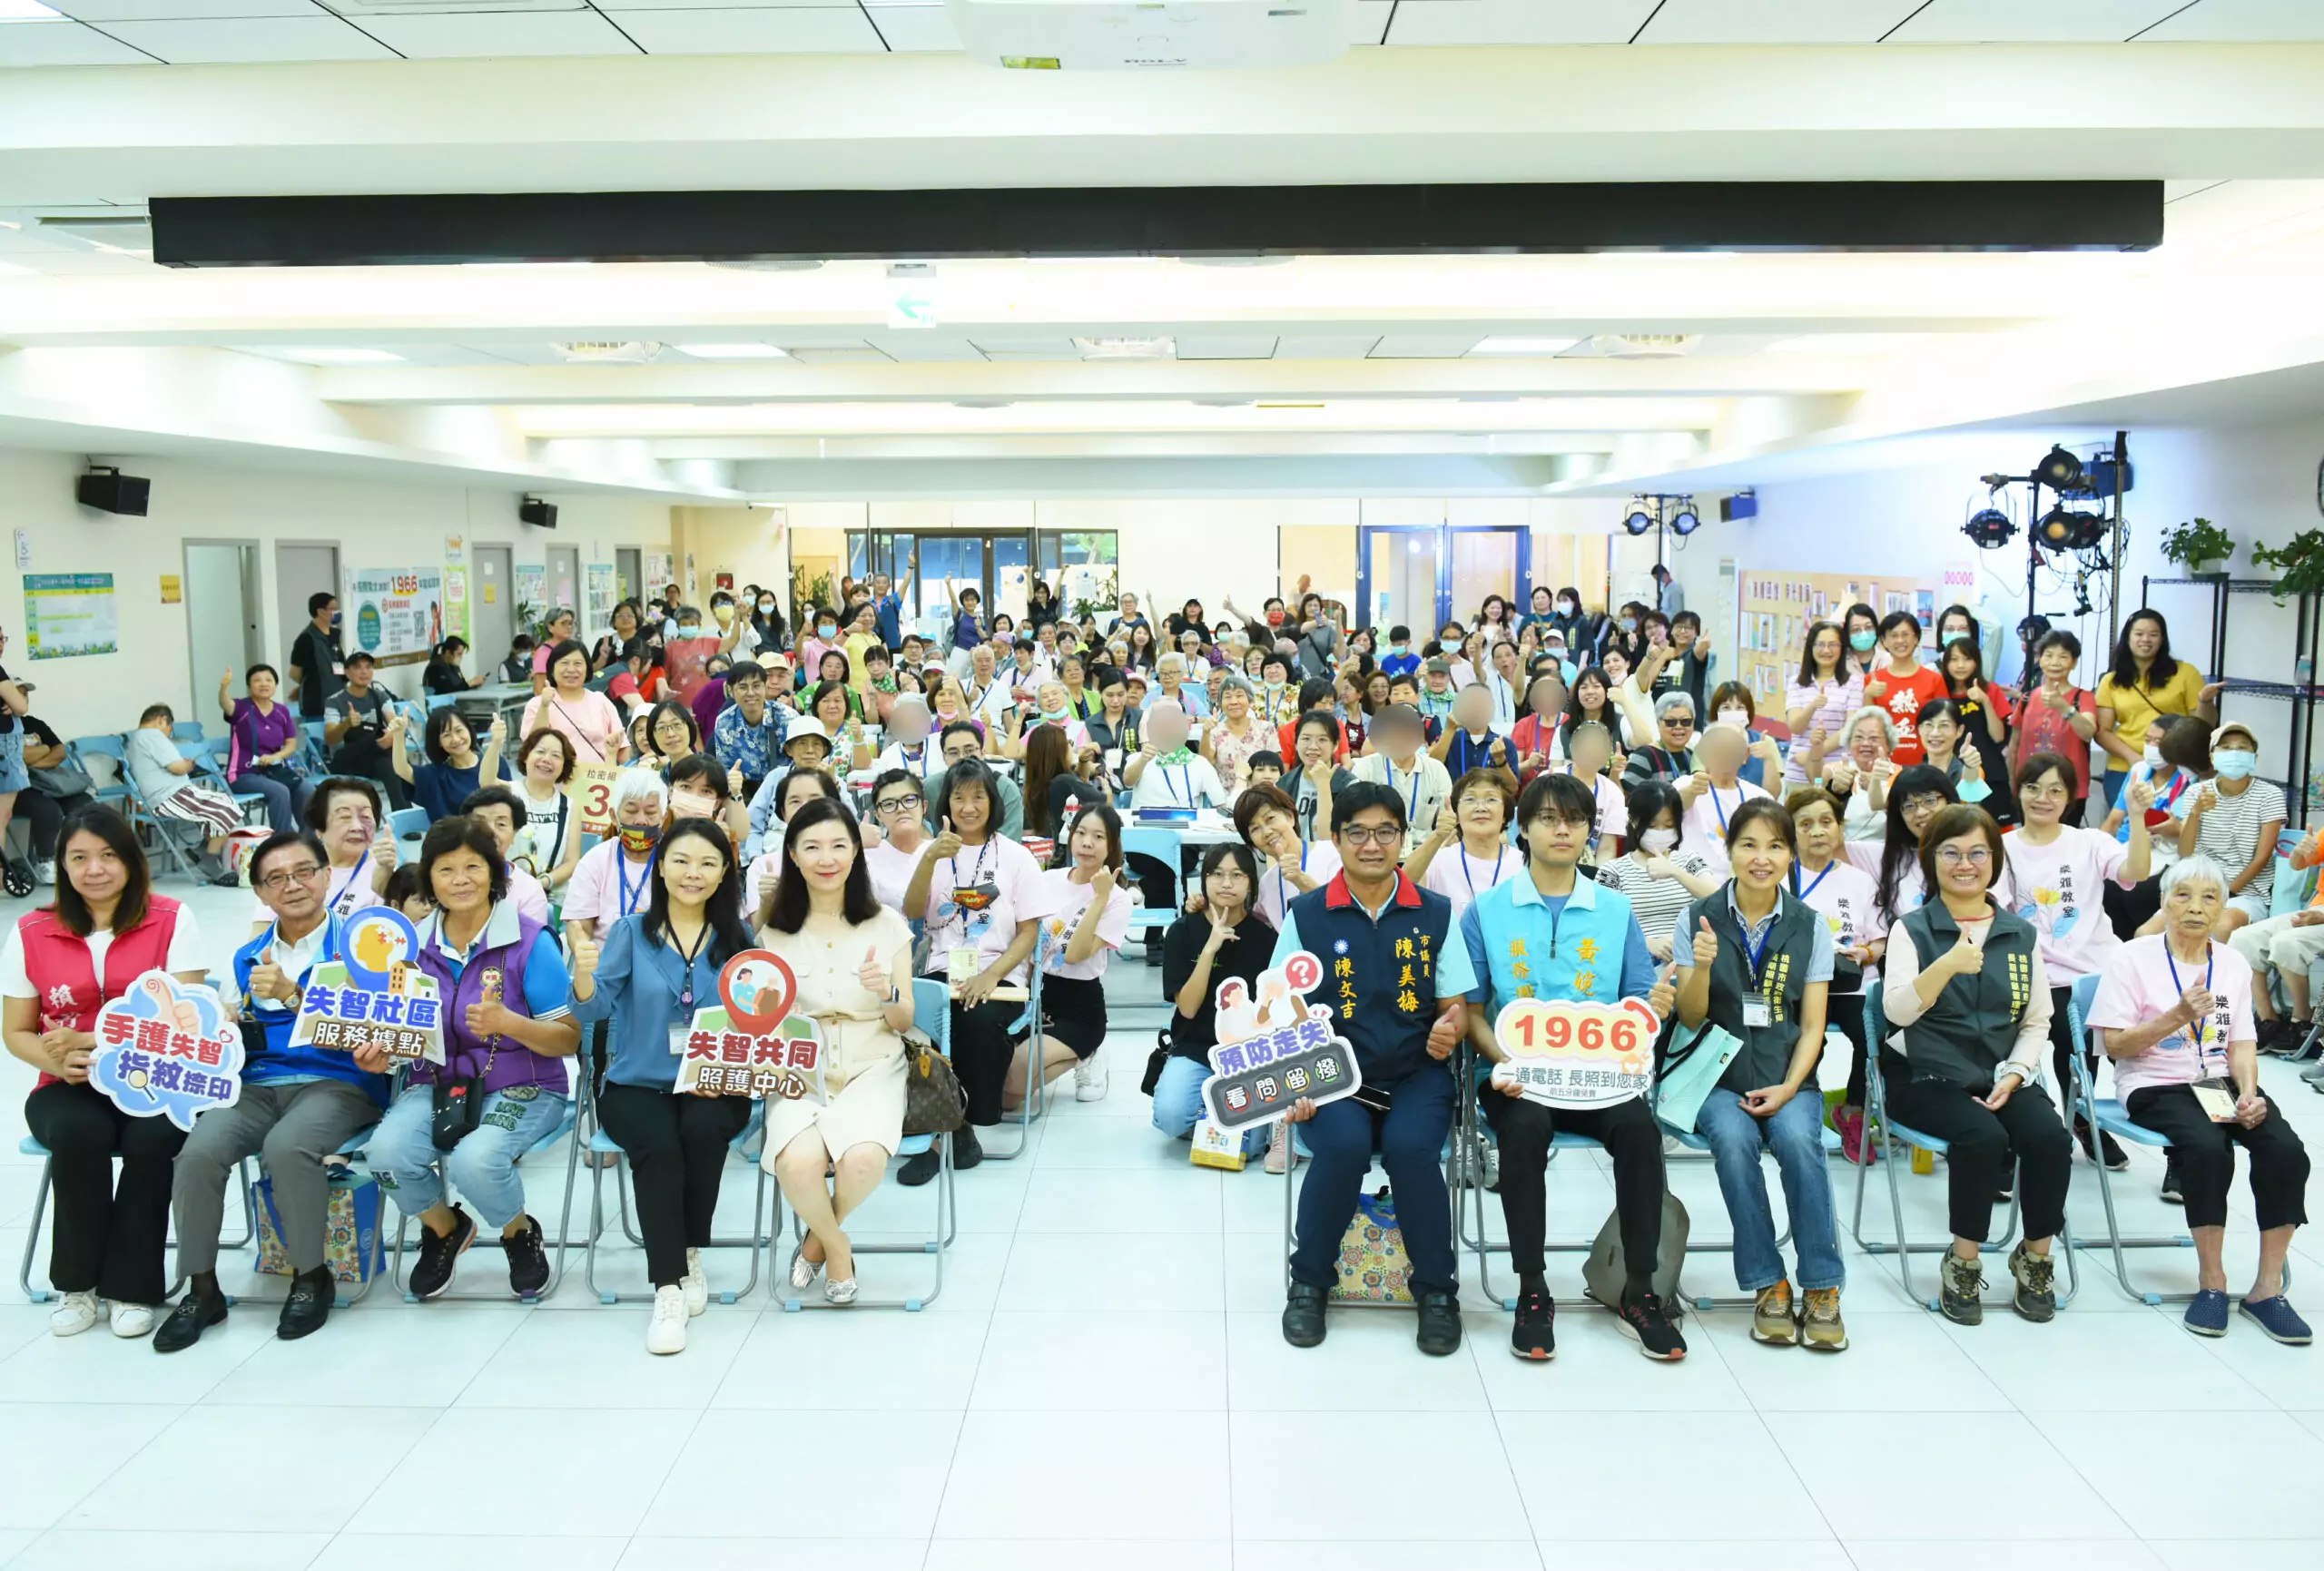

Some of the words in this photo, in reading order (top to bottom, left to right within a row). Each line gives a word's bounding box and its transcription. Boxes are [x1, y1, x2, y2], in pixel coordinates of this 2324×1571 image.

[391, 575, 418, 592] 1966
[587, 769, 617, 781] 拉密組
[584, 784, 610, 817] 3
[2059, 864, 2075, 918] 樂雅教室
[1395, 938, 1420, 1013] 陳美梅
[1419, 935, 1432, 978] 市議員
[303, 986, 439, 1029] 失智社區
[1334, 958, 1357, 1020] 陳文吉
[103, 1013, 222, 1065] 手護失智
[313, 1022, 423, 1056] 服務據點
[687, 1031, 818, 1069] 失智共同
[1217, 1021, 1328, 1075] 預防走失
[1515, 1015, 1637, 1052] 1966
[697, 1066, 804, 1096] 照護中心
[1226, 1058, 1341, 1109] 看問留撥
[1500, 1067, 1562, 1085] 一通電話
[1569, 1069, 1648, 1089] 長照到您家
